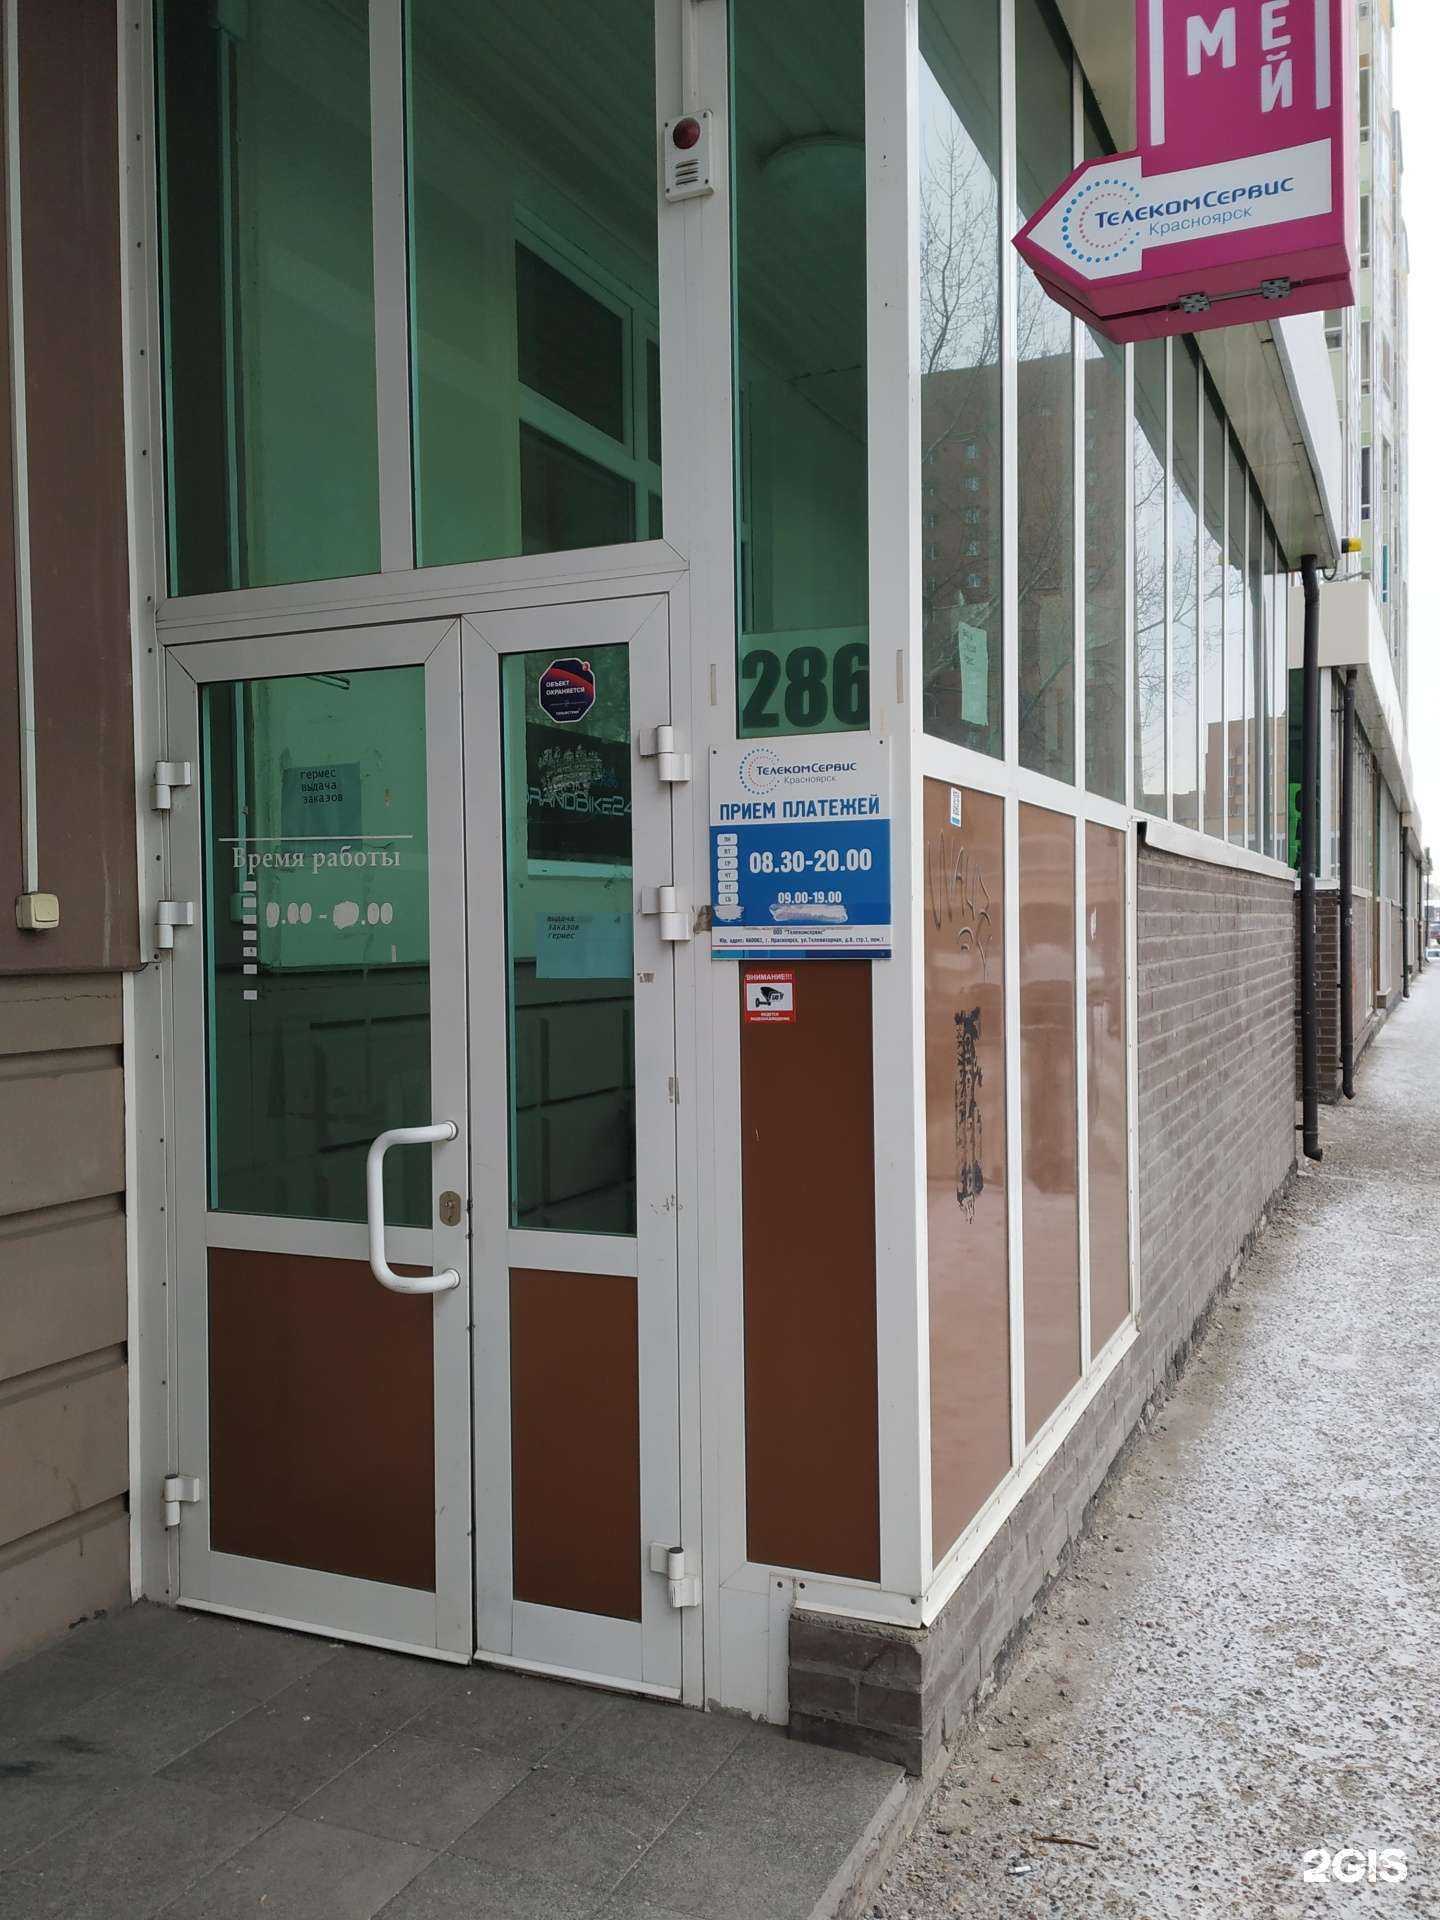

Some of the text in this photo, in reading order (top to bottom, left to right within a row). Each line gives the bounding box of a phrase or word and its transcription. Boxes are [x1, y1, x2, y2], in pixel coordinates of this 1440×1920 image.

[1148, 205, 1253, 236] Красноярск
[545, 687, 585, 696] ОХРАНЯЕТСЯ
[742, 643, 870, 729] 286
[784, 775, 837, 785] Красноярск
[303, 793, 344, 805] заказов
[719, 794, 880, 820] ПРИЕМ ПЛАТЕЖЕЙ
[232, 846, 401, 876] Время работы
[749, 848, 872, 874] 08.30-20.00
[777, 891, 842, 904] 09.00-19.00
